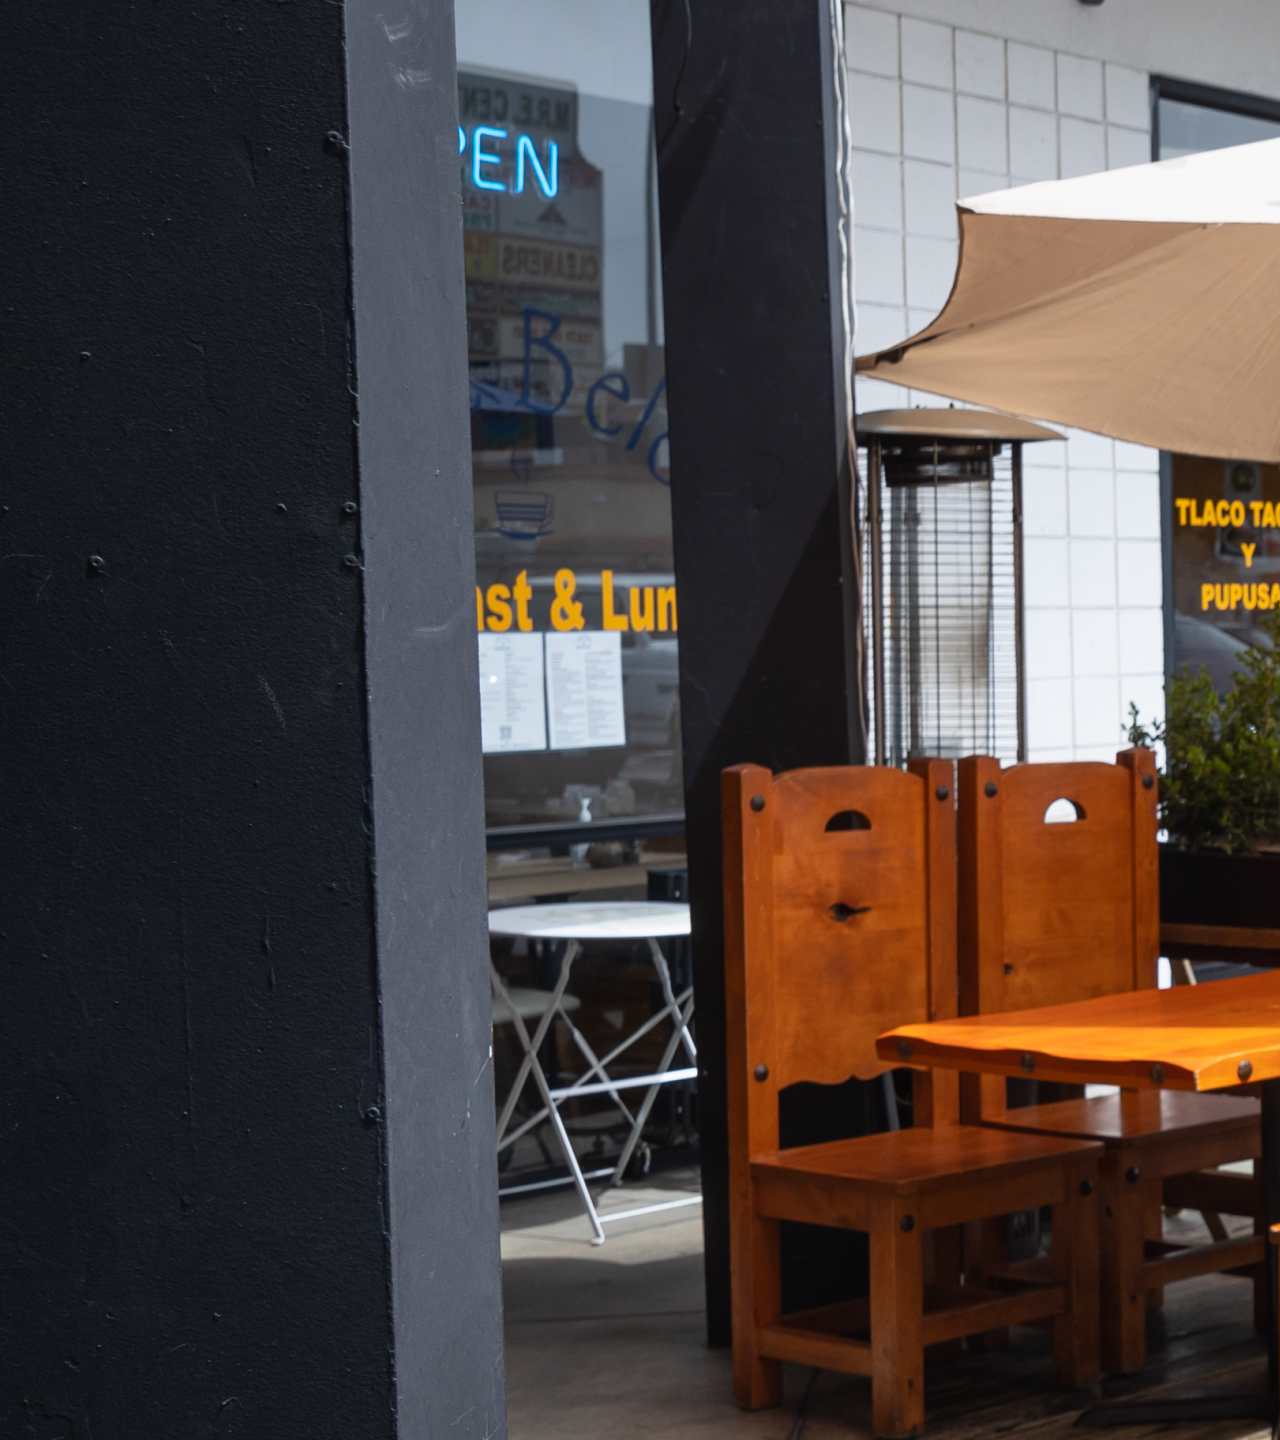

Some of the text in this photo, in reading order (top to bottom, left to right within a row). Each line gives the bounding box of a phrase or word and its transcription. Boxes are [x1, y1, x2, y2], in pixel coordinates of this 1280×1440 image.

[458, 125, 559, 198] EN
[1175, 499, 1245, 527] TLACO
[1240, 543, 1256, 567] Y
[551, 568, 585, 632] &
